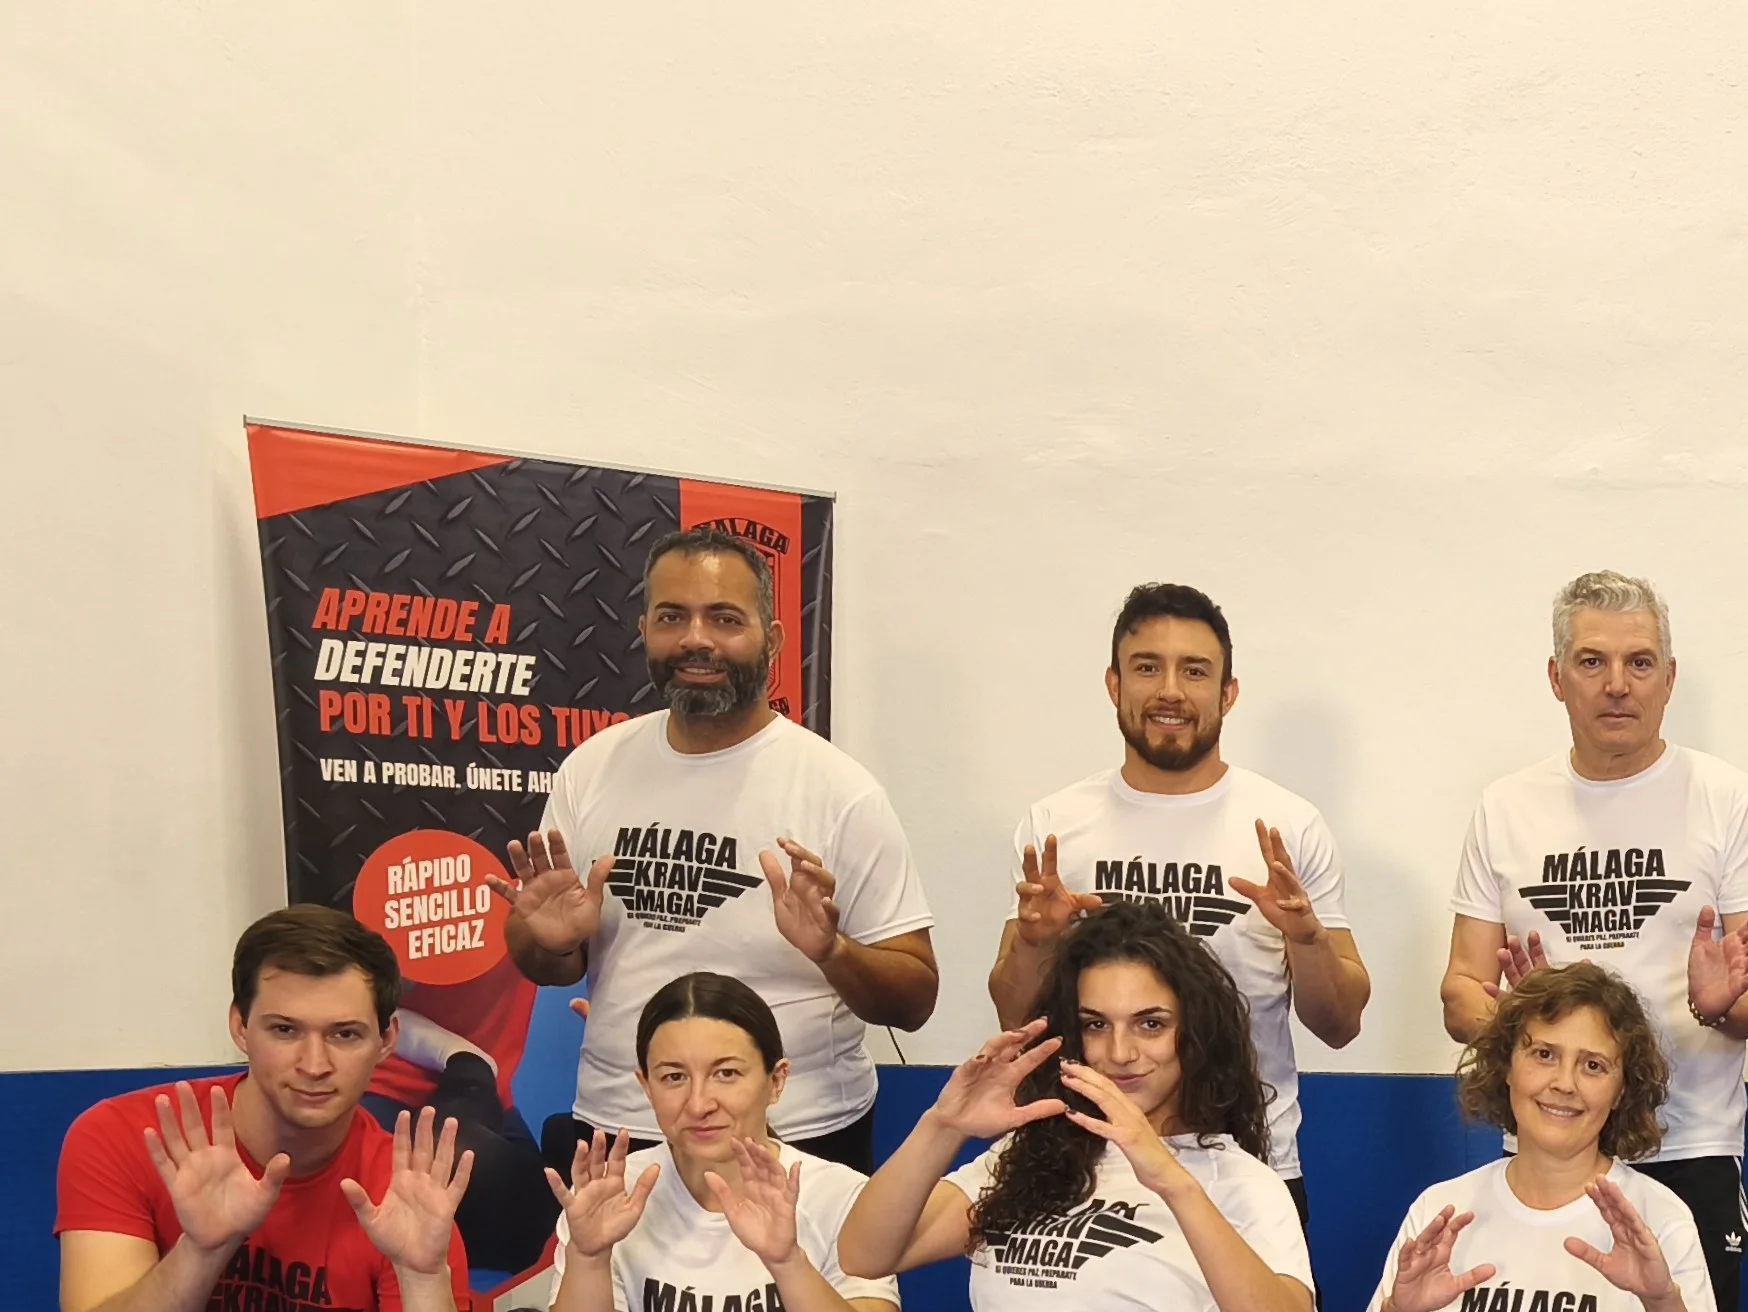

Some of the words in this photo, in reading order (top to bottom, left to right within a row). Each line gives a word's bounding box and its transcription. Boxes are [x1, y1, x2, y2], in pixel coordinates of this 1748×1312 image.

[312, 587, 479, 641] APRENDE
[484, 603, 511, 645] A
[313, 638, 536, 695] DEFENDERTE
[318, 690, 391, 735] POR
[402, 695, 432, 739] TI
[444, 698, 465, 740] Y
[478, 702, 541, 745] LOS
[551, 706, 640, 747] TUY
[320, 758, 357, 782] VEN
[364, 761, 377, 783] A
[382, 762, 461, 789] PROBAR.
[466, 762, 522, 792] ÚNETE
[613, 821, 737, 870] MÁLAGA
[1542, 846, 1666, 883] MÁLAGA
[388, 853, 471, 895] RÁPIDO
[634, 859, 703, 892] KRAV
[1095, 855, 1225, 896] MÁLAGA
[385, 884, 491, 929] SENCILLO
[635, 888, 697, 918] MAGA
[1568, 880, 1636, 910] KRAV
[408, 918, 485, 960] EFICAZ
[1572, 908, 1632, 934] MAGA
[1004, 1237, 1075, 1269] MAGA
